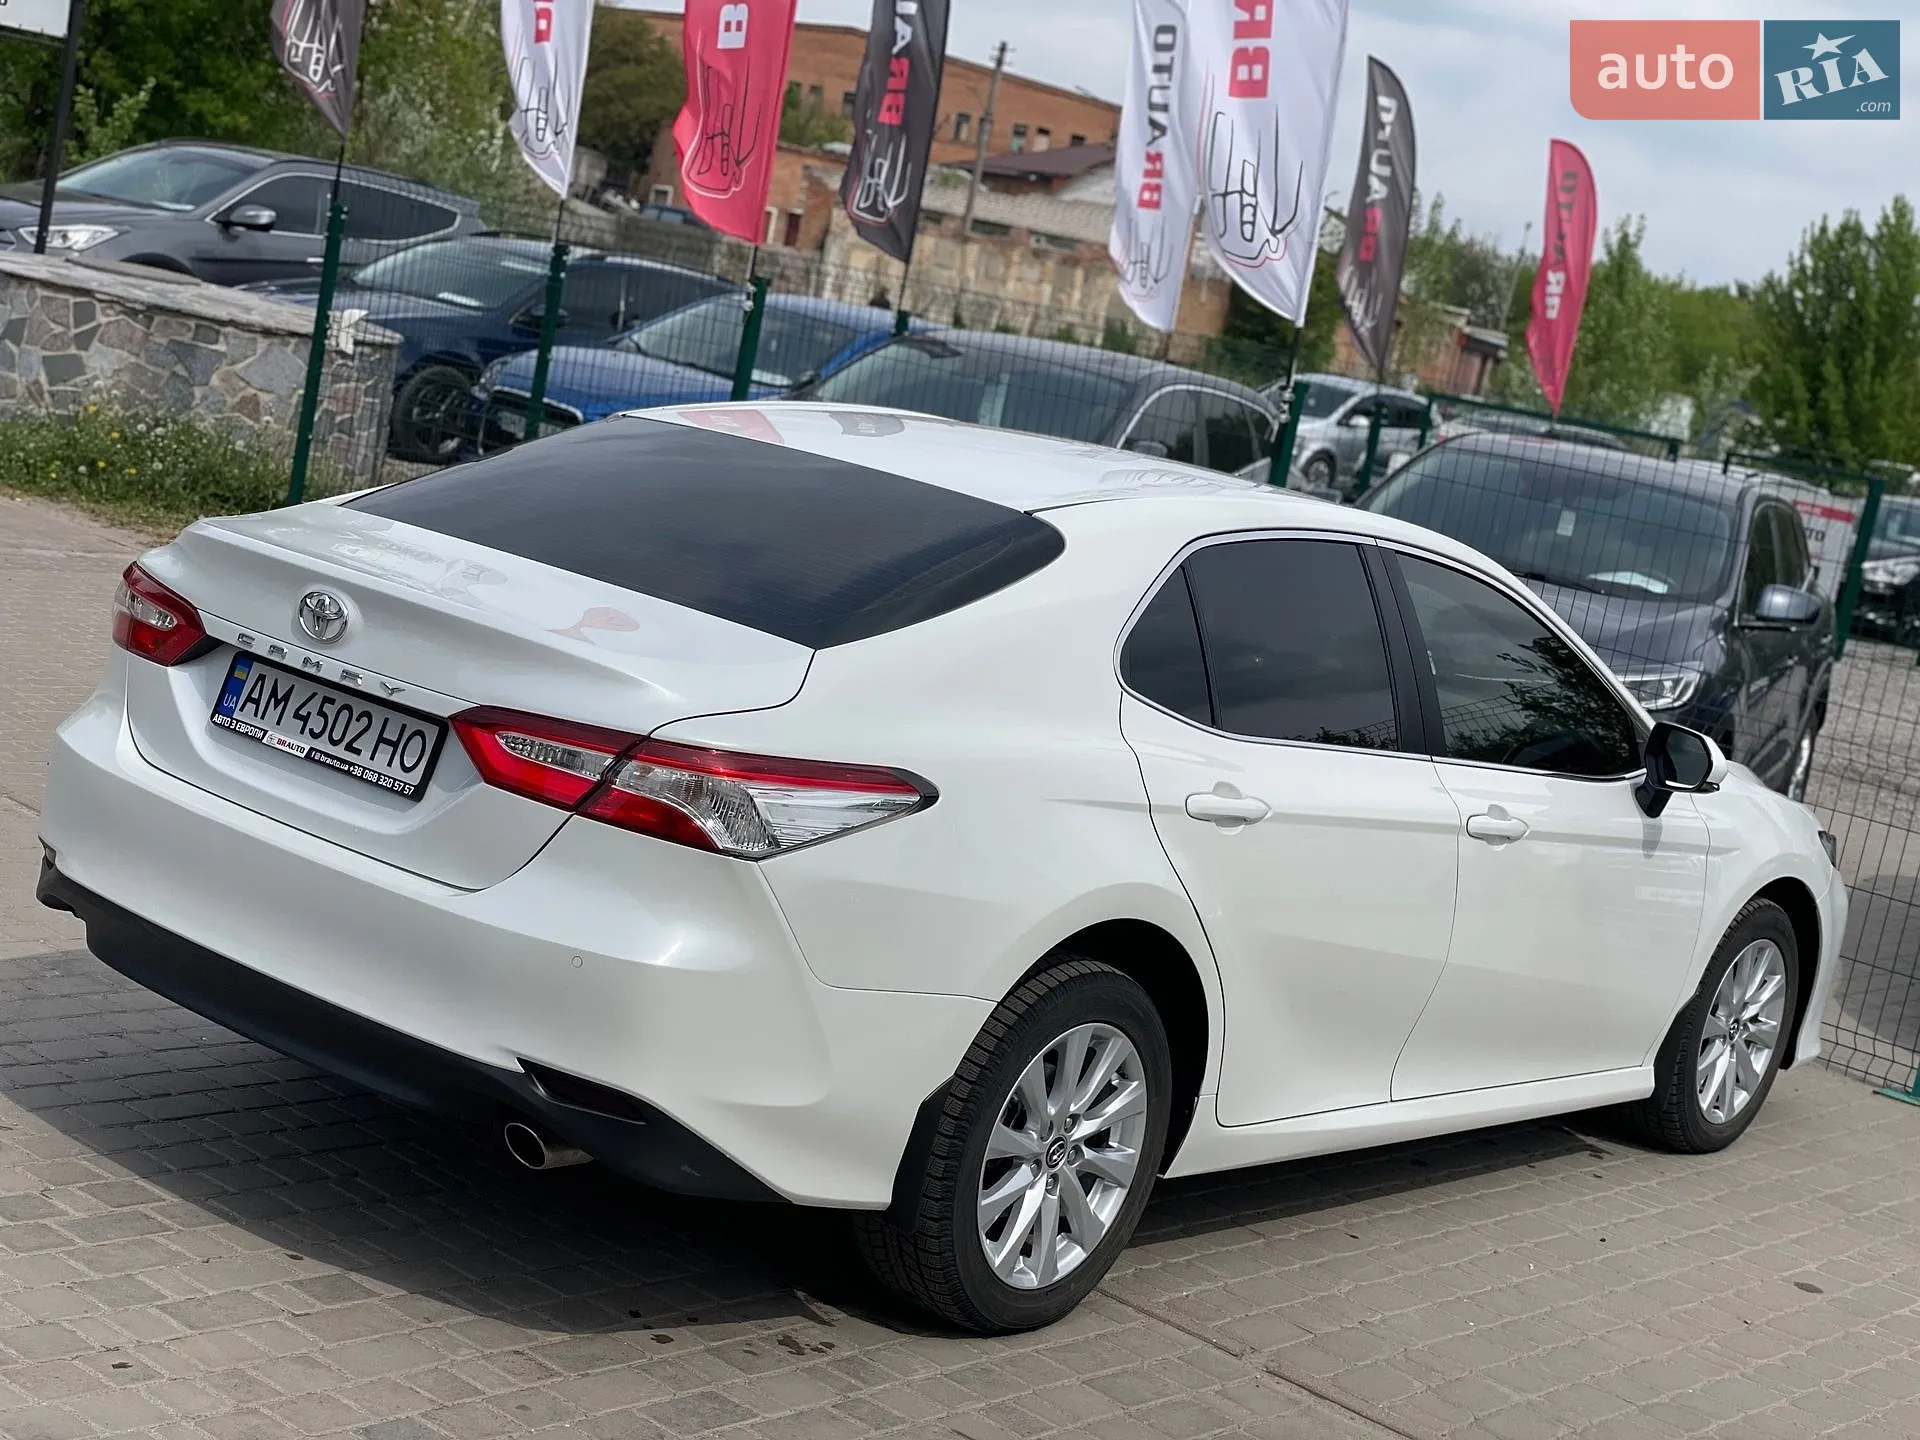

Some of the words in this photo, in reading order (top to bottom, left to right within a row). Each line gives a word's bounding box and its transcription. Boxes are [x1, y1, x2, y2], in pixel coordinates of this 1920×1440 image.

[237, 632, 406, 697] CAMRY
[223, 692, 237, 710] UA
[239, 672, 296, 726] AM
[292, 691, 363, 756] 4502
[369, 716, 427, 774] HO
[276, 738, 306, 754] BRAUTO
[349, 765, 363, 777] +38
[363, 769, 379, 783] 068
[378, 774, 393, 788] 320
[393, 780, 405, 792] 57
[404, 784, 415, 796] 57
